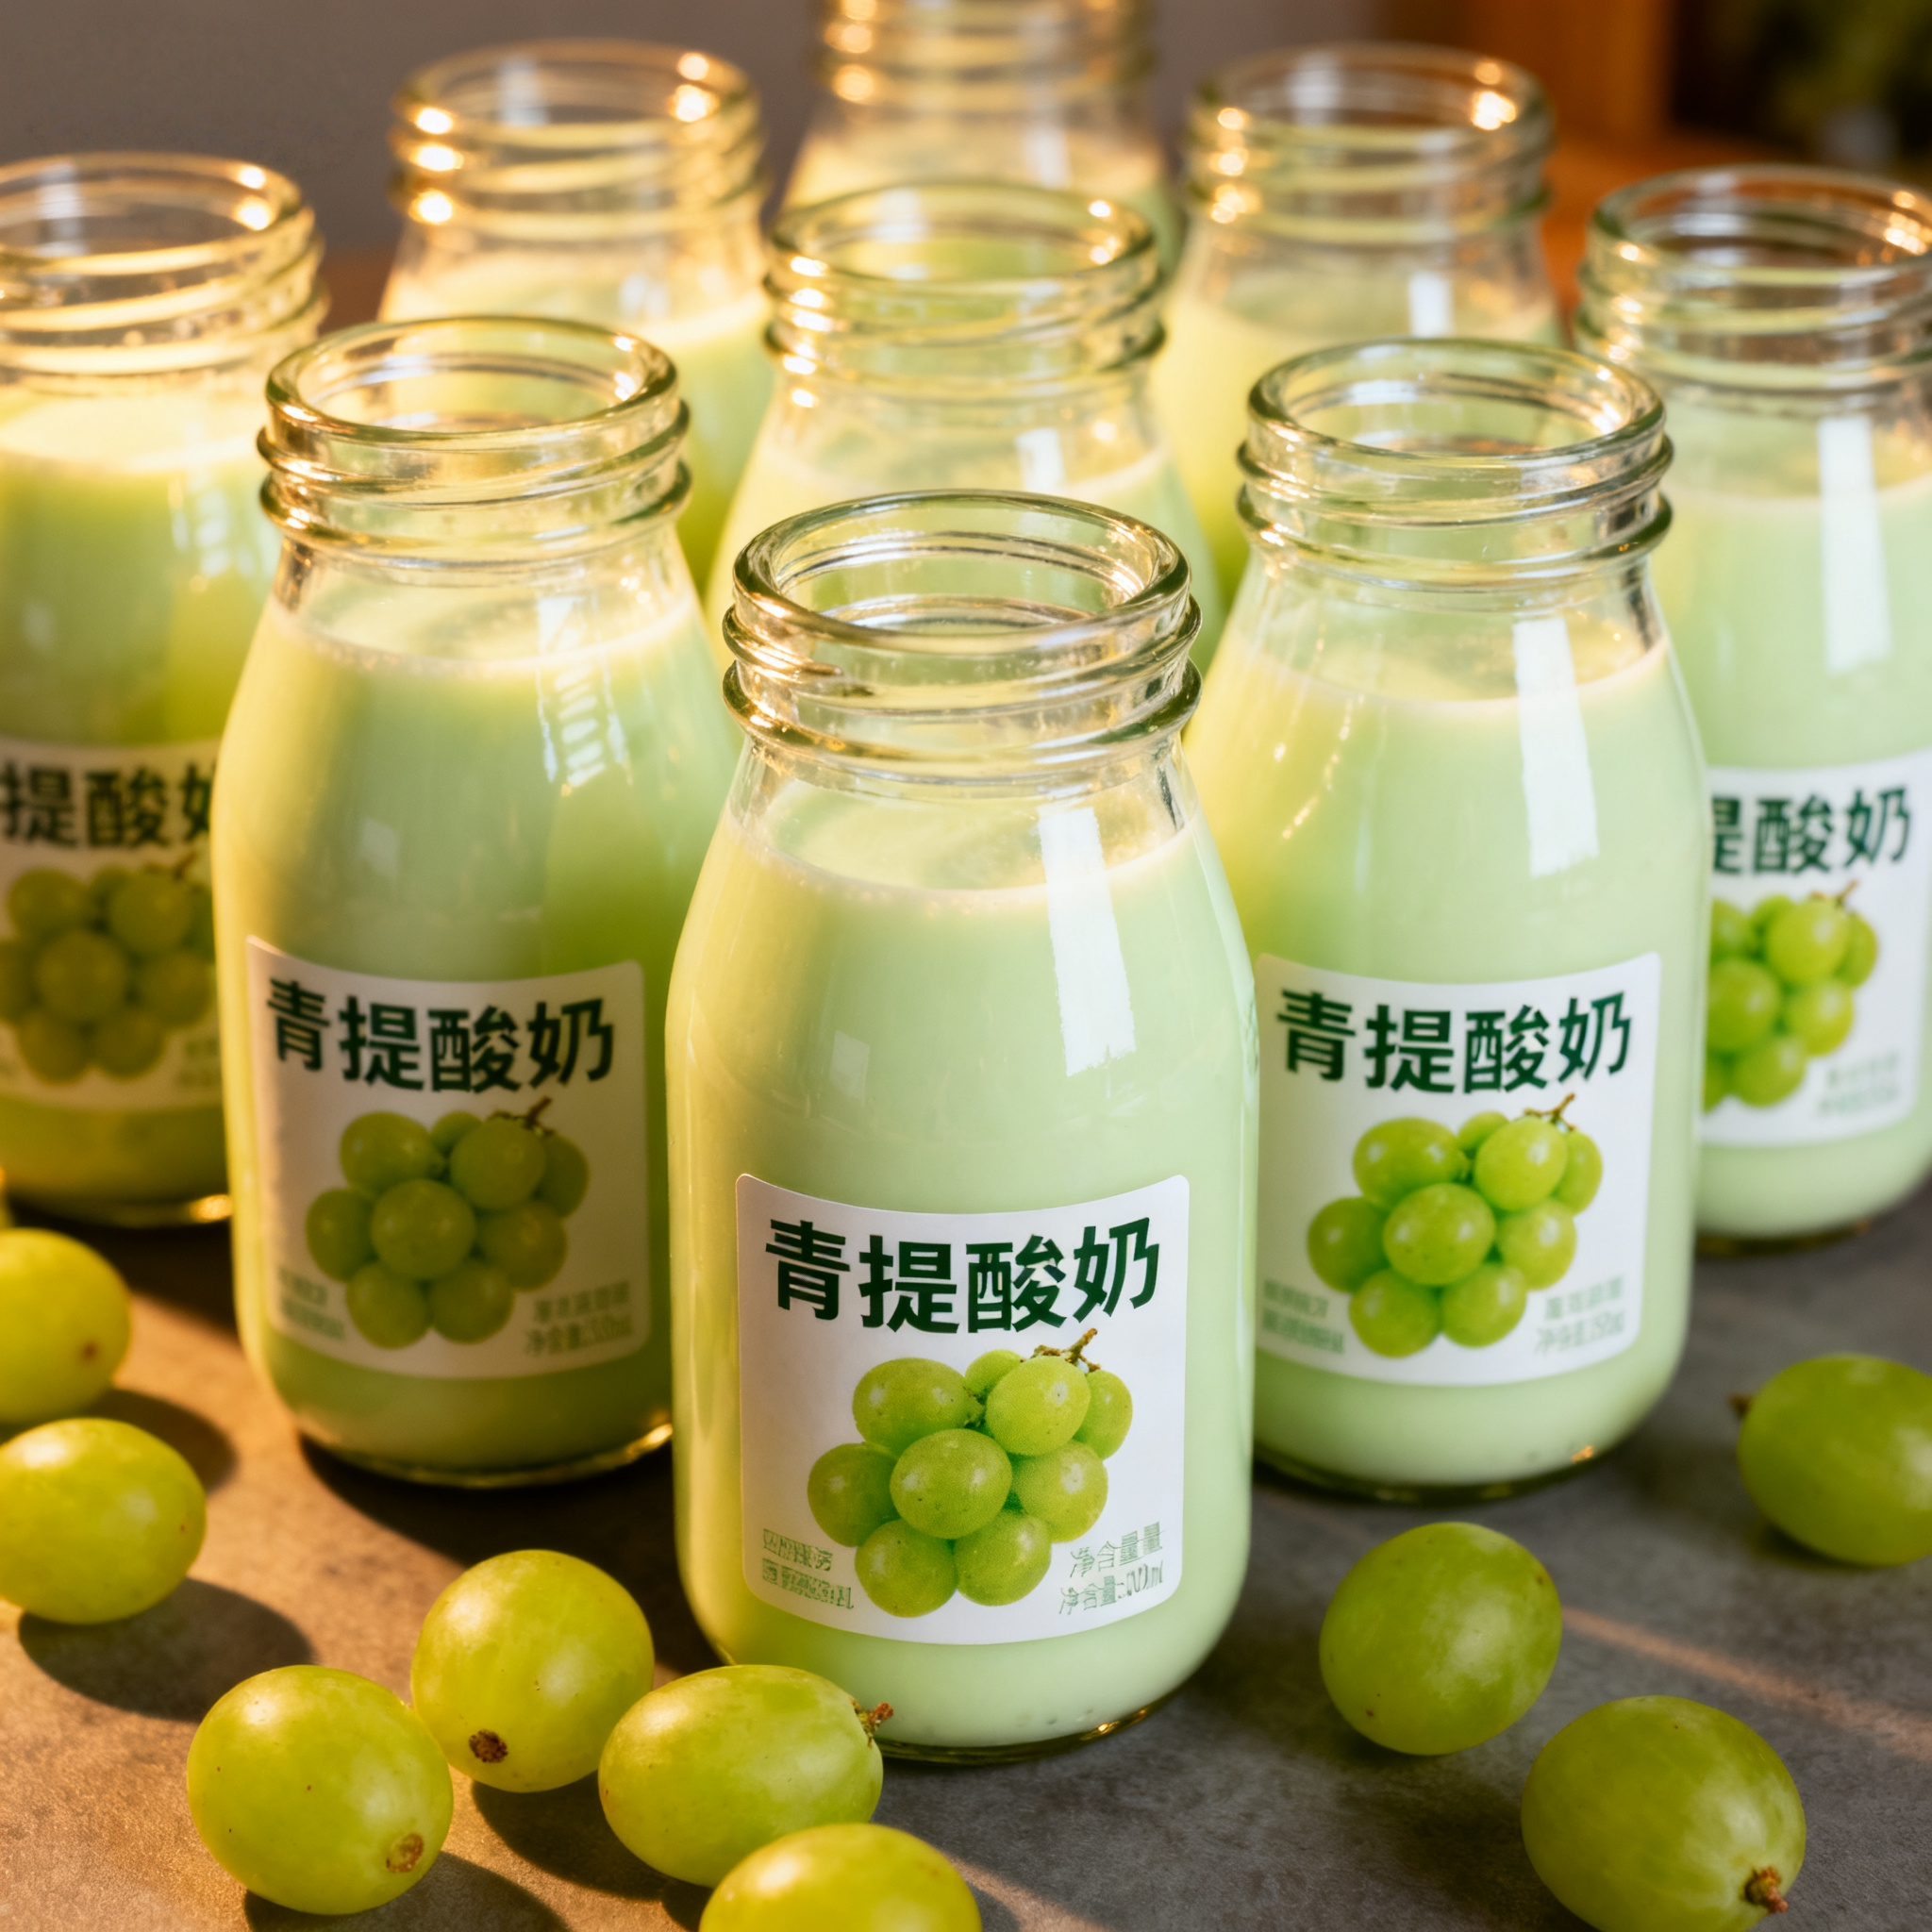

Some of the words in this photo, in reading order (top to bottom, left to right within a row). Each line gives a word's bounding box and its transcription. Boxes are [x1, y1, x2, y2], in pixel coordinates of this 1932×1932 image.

[267, 976, 615, 1093] 青提酸奶
[1275, 989, 1632, 1095] 青提酸奶
[764, 1216, 1160, 1334] 青提酸奶
